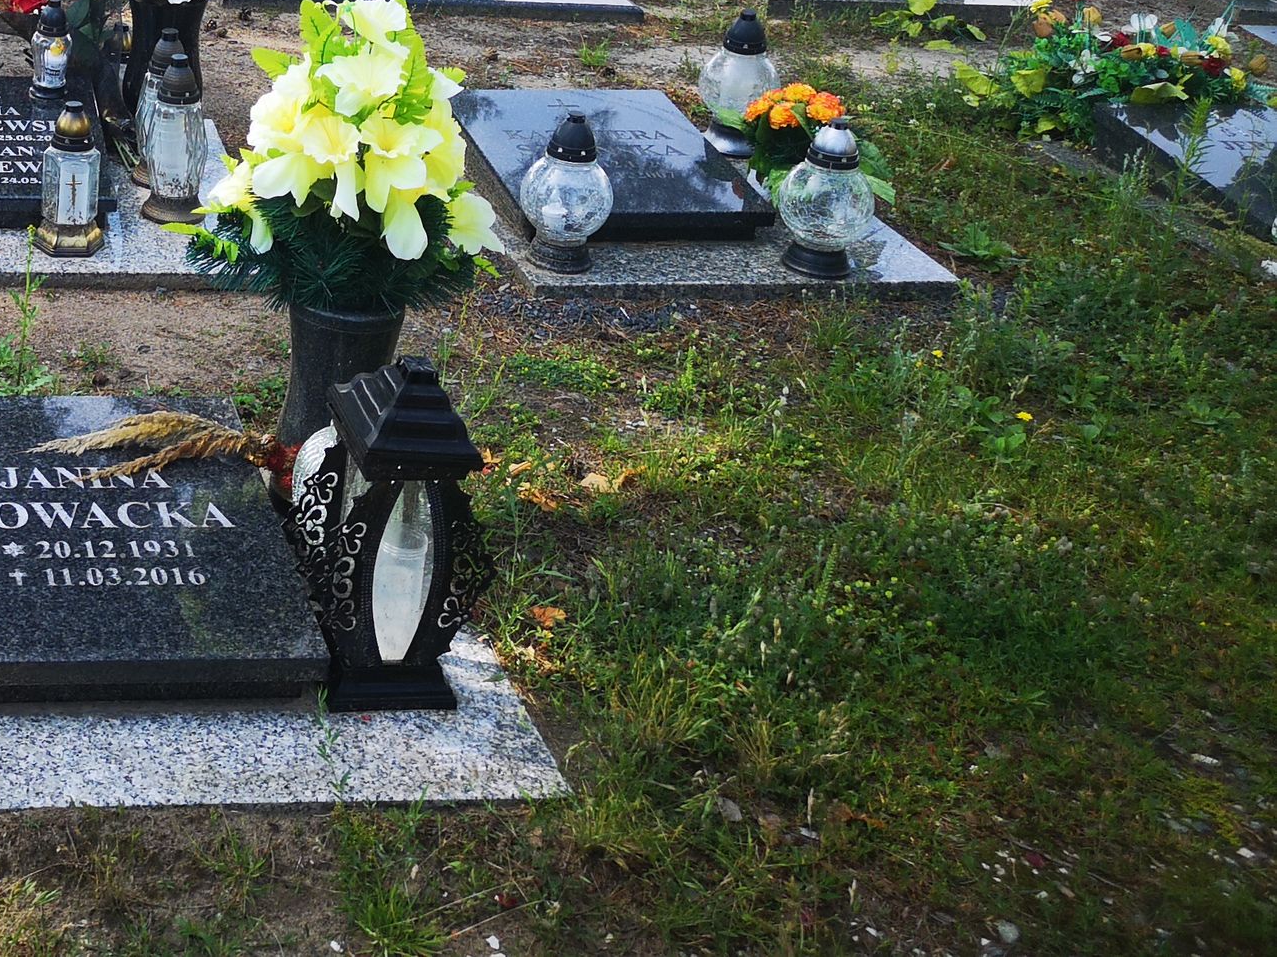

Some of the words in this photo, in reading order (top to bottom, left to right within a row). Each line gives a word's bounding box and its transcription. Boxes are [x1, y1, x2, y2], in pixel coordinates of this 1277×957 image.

[0, 176, 42, 184] 24.05.
[38, 540, 196, 560] 20.12.1931
[44, 567, 207, 587] 11.03.2016
